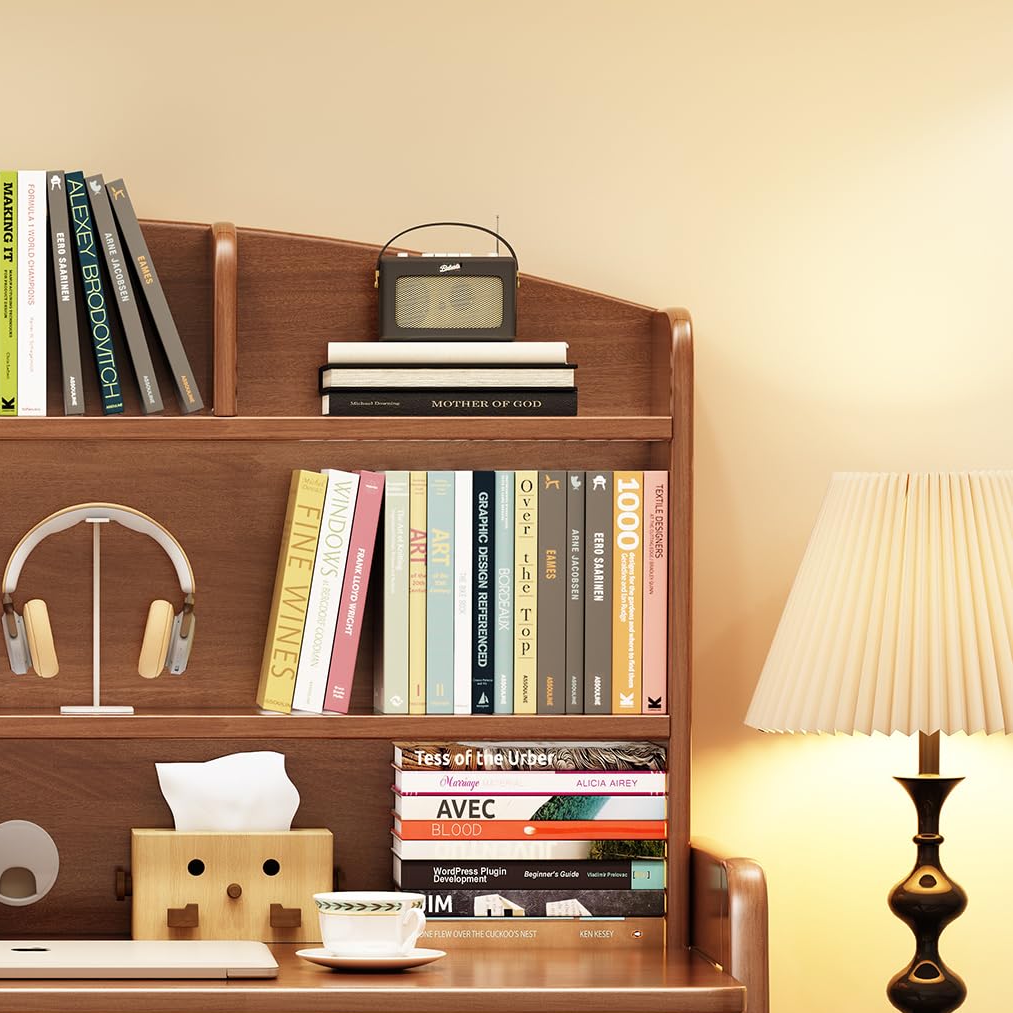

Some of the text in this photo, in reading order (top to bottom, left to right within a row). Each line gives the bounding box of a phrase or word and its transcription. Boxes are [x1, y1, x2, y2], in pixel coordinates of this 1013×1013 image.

[3, 182, 13, 262] MAKING IT
[56, 232, 70, 302] EERO SAARINEN
[104, 232, 129, 302] ARNE JACOBSEN
[137, 255, 154, 285] EAMES
[67, 178, 96, 259] ALEXEY
[83, 264, 120, 399] BRODOVITCH
[431, 400, 542, 408] MOTHER OF GOD
[617, 477, 641, 551] 1000
[654, 484, 664, 559] TEXTILE DESIGNERS
[287, 503, 321, 572] FINE
[319, 480, 353, 578] WINDOWS
[409, 528, 426, 566] ART
[431, 528, 450, 567] ART
[520, 479, 533, 656] Over the Top
[546, 549, 556, 580] EAMES
[571, 528, 580, 601] ARNE JACOBSEN
[593, 532, 605, 602] EERO SAARINEN
[627, 552, 636, 574] designs
[344, 547, 366, 635] FRANK LLOYD WRIGHT
[477, 491, 489, 668] GRAPHIC DESIGN REFERENCED
[619, 581, 627, 592] and
[627, 585, 636, 595] the
[628, 575, 636, 584] for
[498, 567, 510, 631] BORDEAUX
[626, 596, 635, 620] gardens
[270, 584, 309, 682] WINES
[627, 620, 635, 632] and
[627, 633, 635, 651] where
[627, 659, 635, 671] find
[627, 673, 635, 688] them
[414, 749, 555, 766] Tess of the Urber
[440, 775, 480, 791] Marriage
[576, 779, 638, 787] ALICIA AIREY
[436, 799, 495, 819] AVEC
[432, 823, 482, 836] BLOOD
[433, 866, 507, 878] WordPress Plugin
[433, 875, 487, 884] Development
[524, 870, 580, 879] Beginner's Guide
[428, 894, 453, 914] IM
[434, 930, 452, 938] FLEW
[453, 930, 472, 938] OVER
[472, 930, 485, 938] THE
[485, 930, 520, 938] CUCKOO'S
[520, 930, 537, 938] NEST
[579, 930, 614, 938] KEN KESEY
